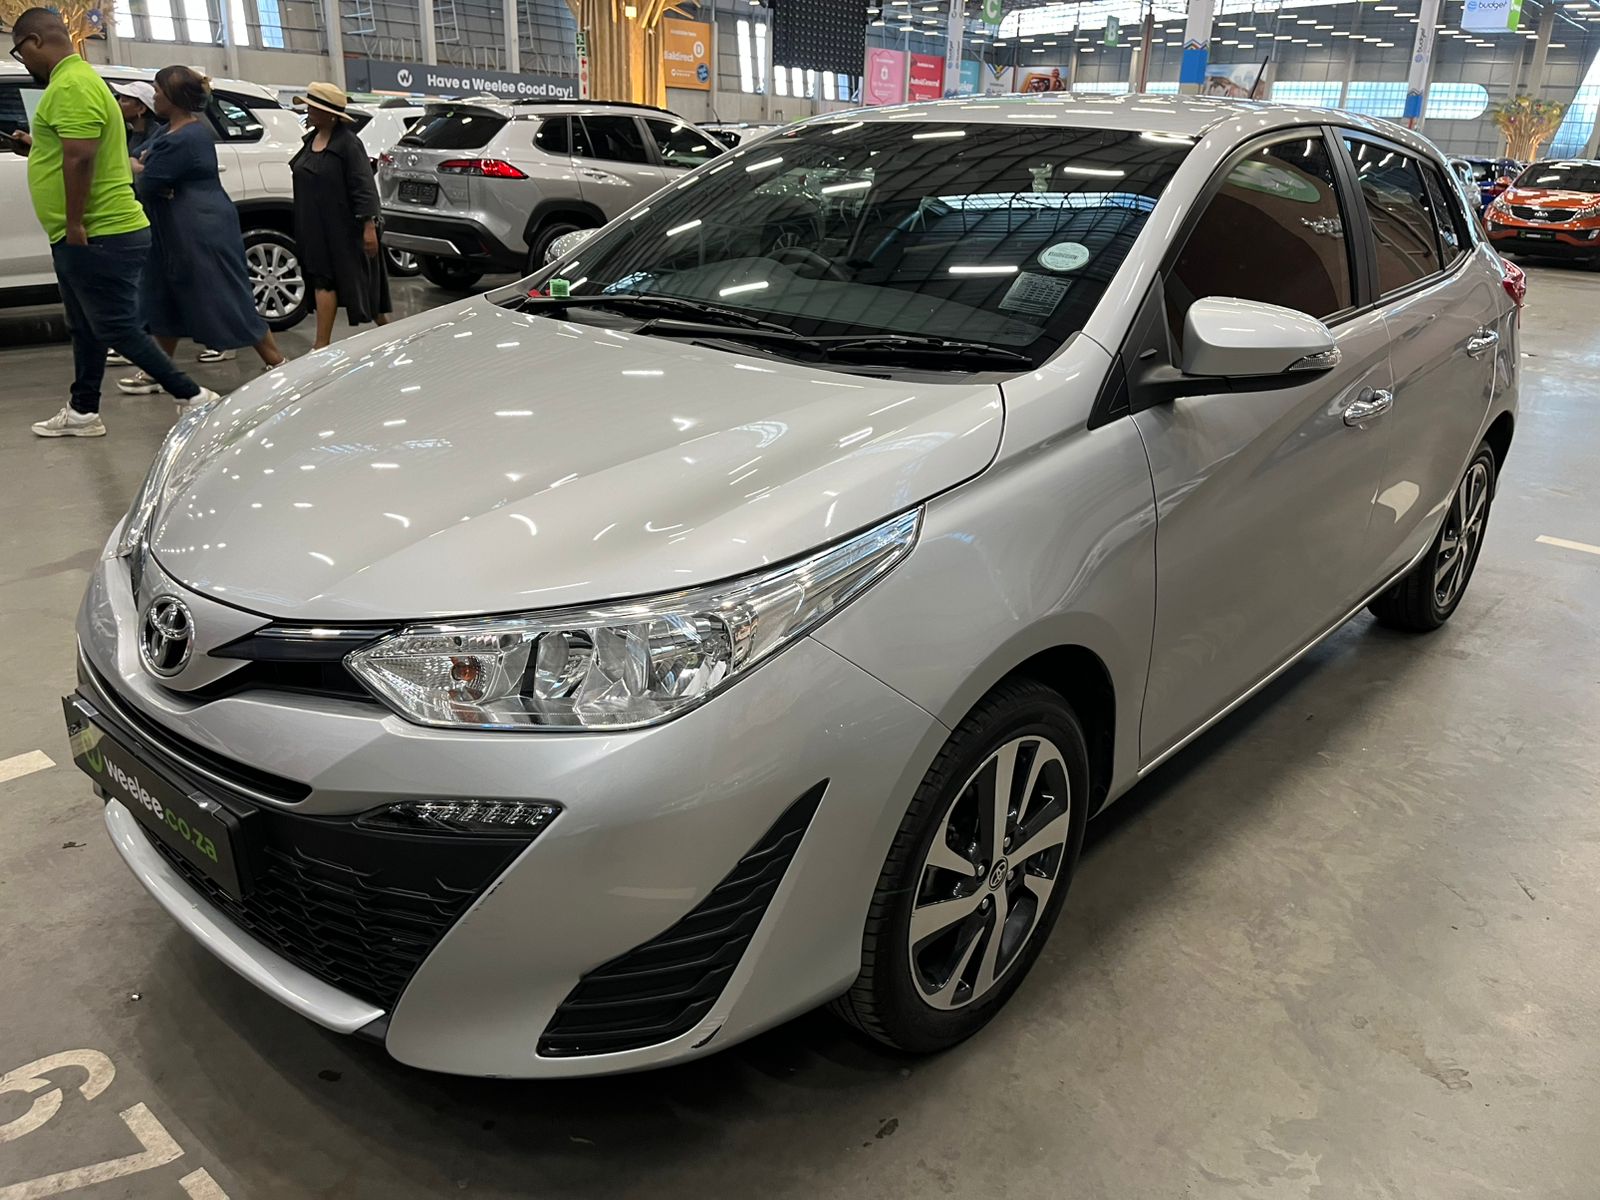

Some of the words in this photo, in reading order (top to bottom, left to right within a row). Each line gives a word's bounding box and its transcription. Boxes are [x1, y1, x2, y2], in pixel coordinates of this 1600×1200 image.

[1479, 1, 1507, 10] budget
[427, 74, 460, 88] Have
[462, 79, 470, 89] a
[472, 78, 516, 93] Weelee
[517, 82, 546, 96] Good
[548, 84, 573, 99] Day!
[104, 755, 218, 863] weelee.co.za
